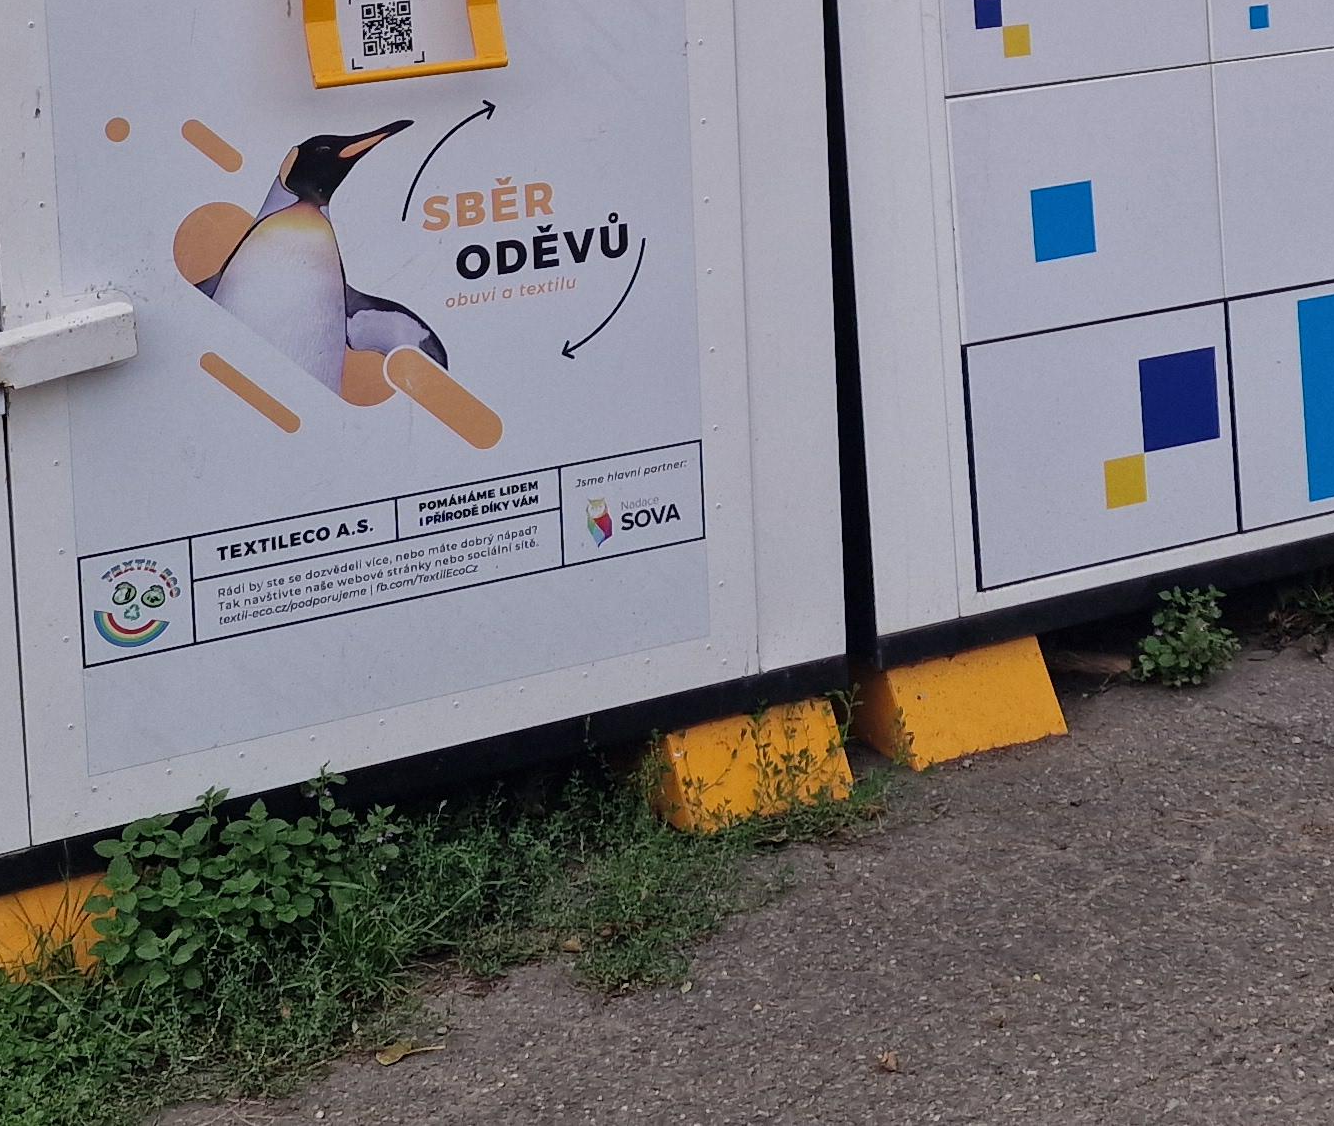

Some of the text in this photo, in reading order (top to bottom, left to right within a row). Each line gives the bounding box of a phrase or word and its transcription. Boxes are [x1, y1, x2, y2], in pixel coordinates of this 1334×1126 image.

[421, 175, 555, 232] SBĚR
[455, 211, 629, 280] ODĚVŮ
[445, 275, 577, 309] obuvi a textilu
[418, 480, 539, 513] POMÁHÁME LIDEM
[574, 475, 605, 489] Jsme
[419, 495, 539, 527] I PŘÍRODĚ DÍKY VÁM
[620, 496, 660, 511] Nadace
[620, 503, 682, 531] SOVA
[216, 518, 374, 561] TEXTILECO A.S.
[100, 558, 158, 583] TEXTIL
[217, 583, 245, 599] Rádi
[248, 580, 264, 594] by
[266, 578, 285, 589] ste
[288, 574, 302, 584] se
[395, 548, 425, 562] nebo
[428, 540, 458, 556] máte
[460, 533, 495, 549] dobrý
[497, 525, 538, 541] nápad?
[158, 567, 181, 598] ECO
[218, 599, 240, 612] Tak
[305, 577, 334, 593] naše
[337, 567, 384, 587] webové
[387, 559, 432, 578] stránky
[435, 553, 465, 568] nebo
[219, 588, 367, 625] textil-eco.cz/podporujeme
[376, 563, 479, 594] fb.com/TextilEcoCz
